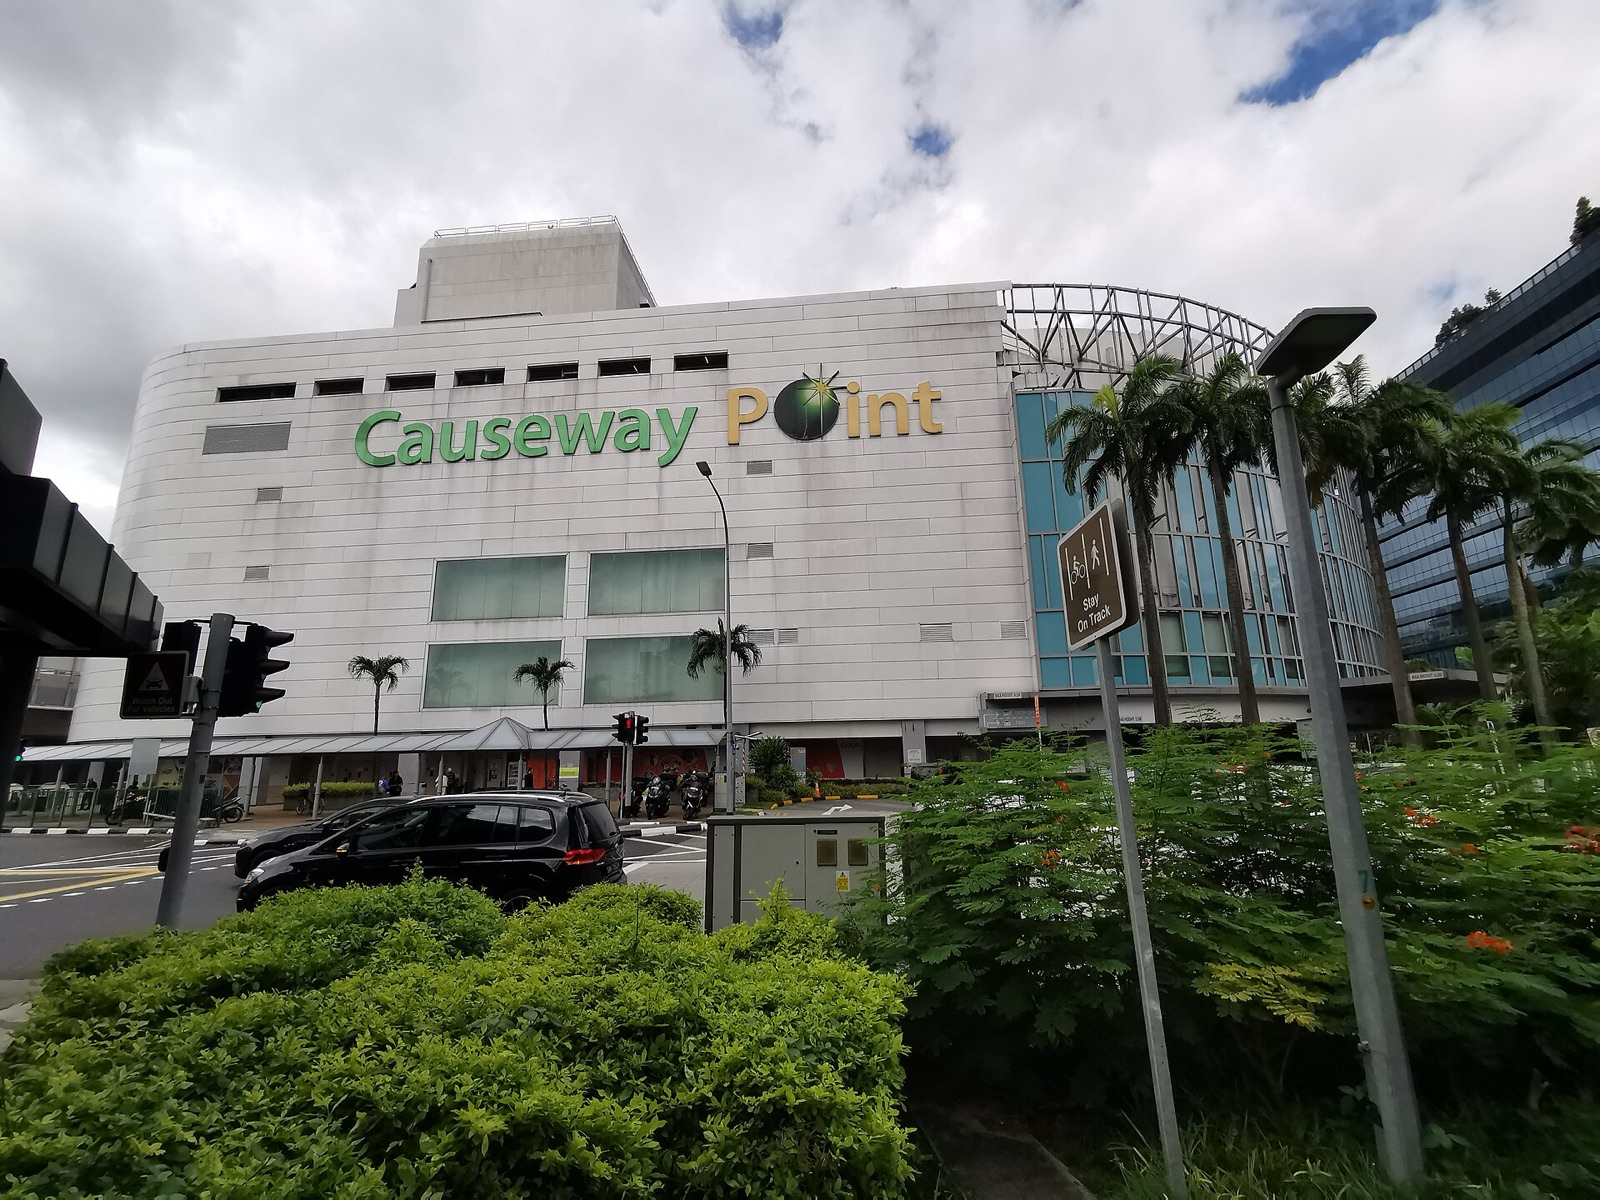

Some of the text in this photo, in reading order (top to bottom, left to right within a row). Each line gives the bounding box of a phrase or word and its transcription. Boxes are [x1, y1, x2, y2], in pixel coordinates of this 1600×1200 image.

[354, 376, 943, 468] Causeway Point
[1083, 593, 1099, 611] Stay
[1077, 604, 1111, 633] On Track
[143, 705, 175, 713] Vehicles
[158, 696, 173, 705] Out
